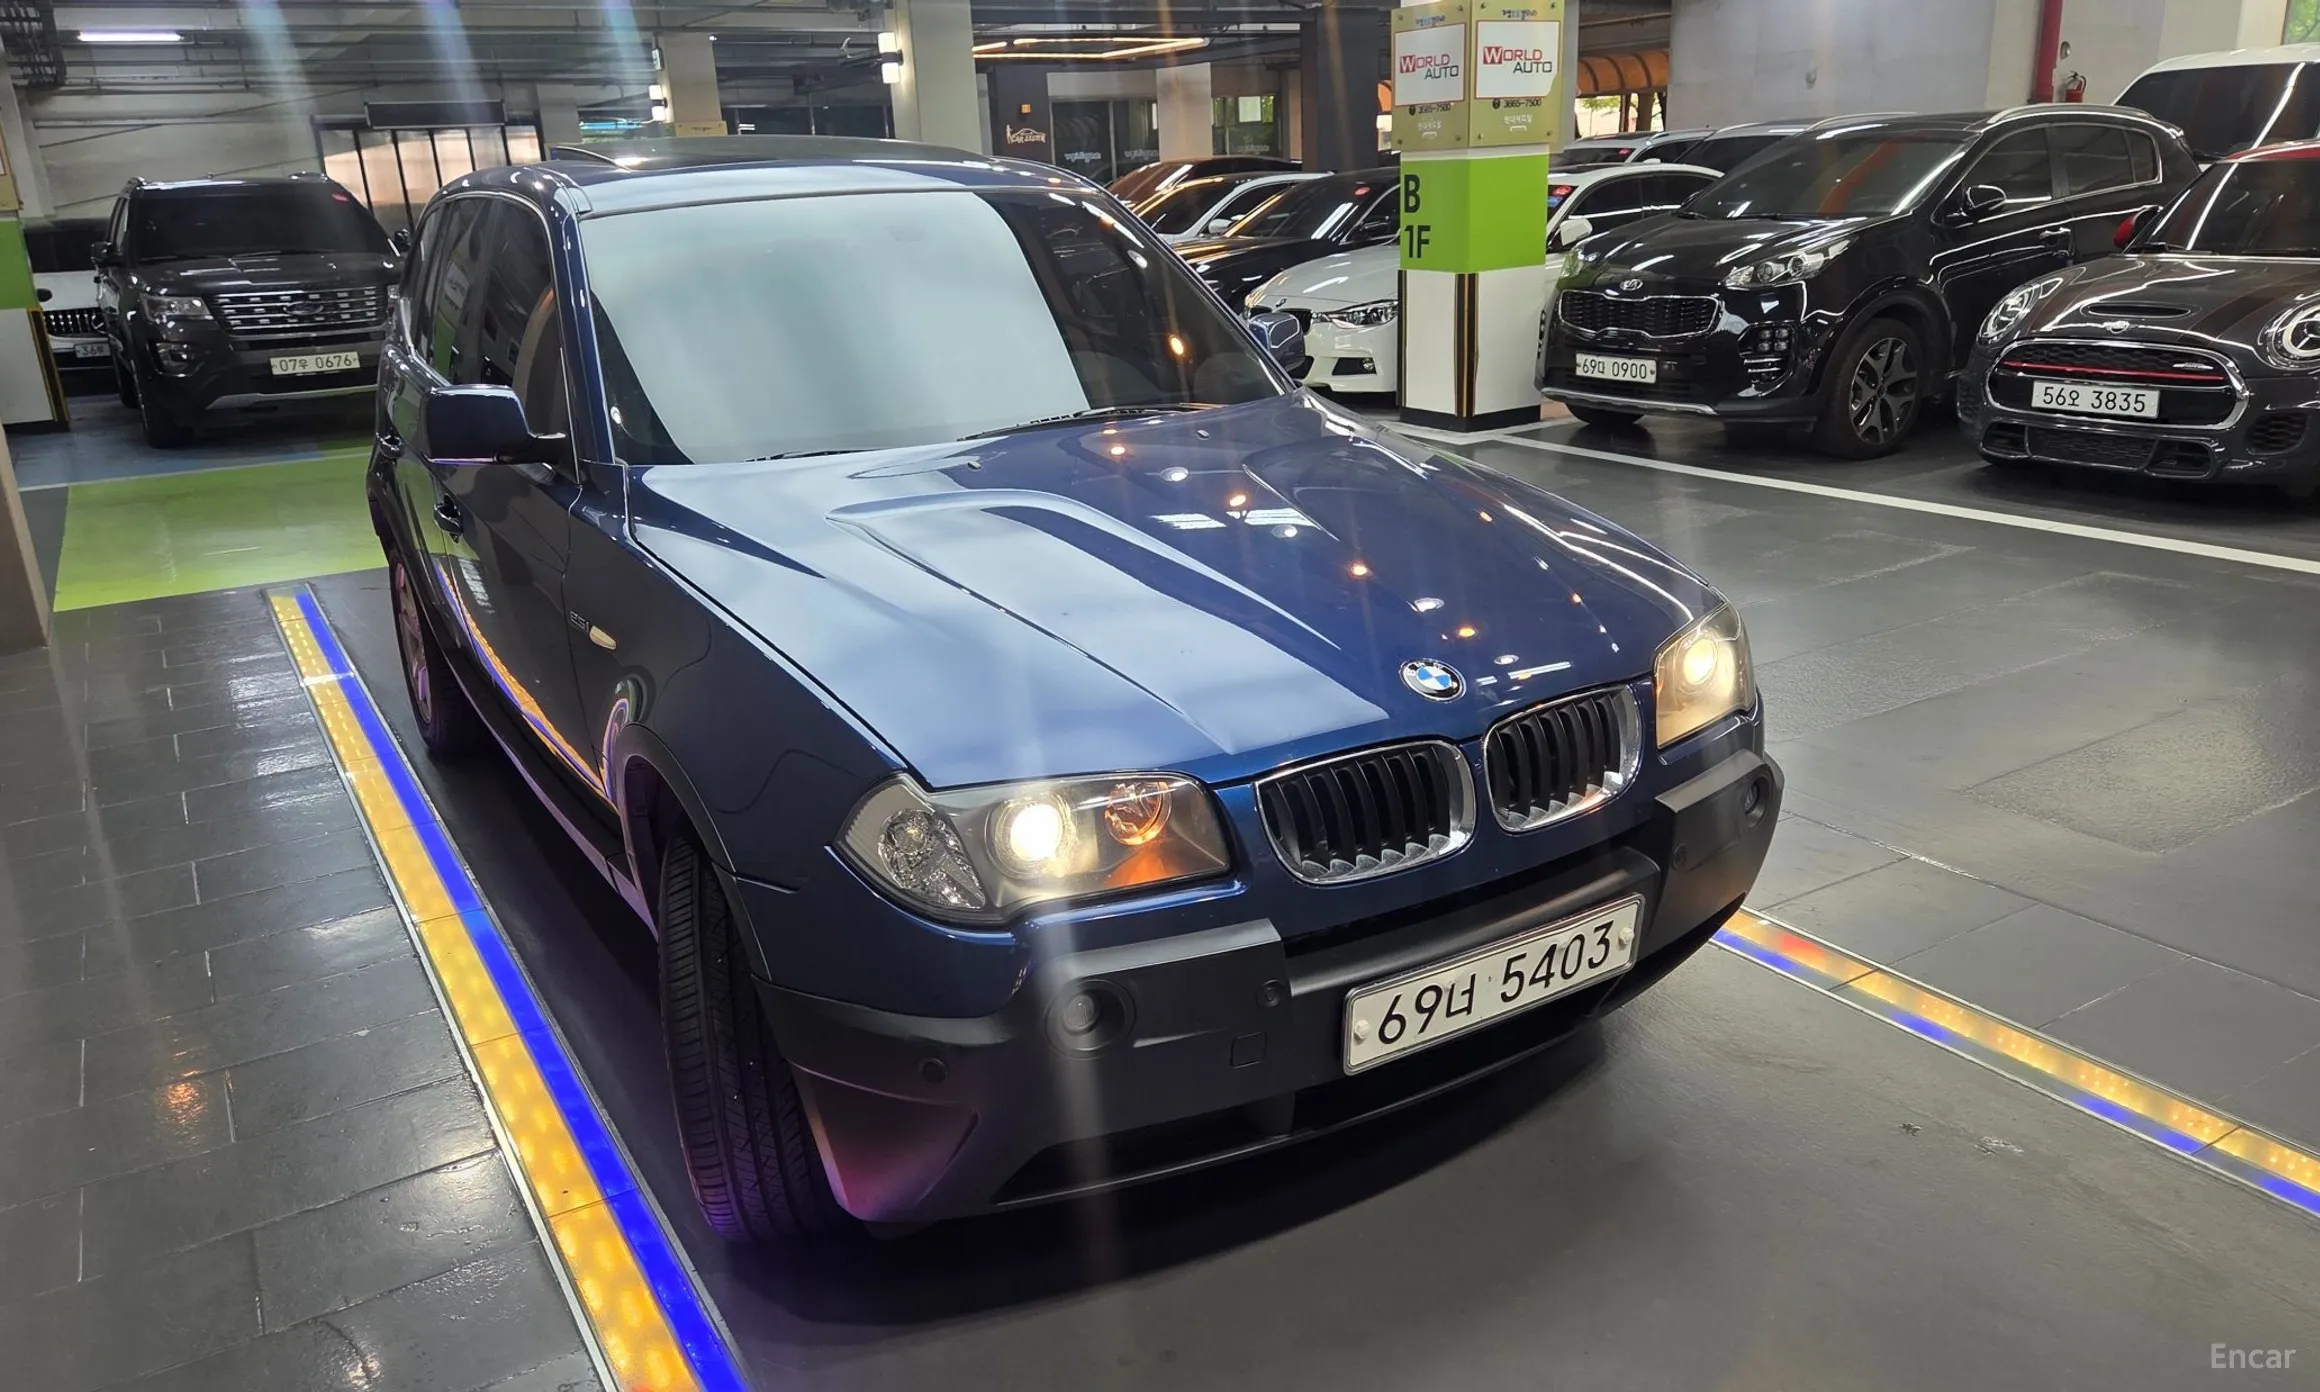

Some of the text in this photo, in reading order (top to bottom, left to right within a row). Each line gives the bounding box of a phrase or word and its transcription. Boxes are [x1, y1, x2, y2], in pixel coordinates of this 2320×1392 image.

[1400, 54, 1450, 73] WORLD
[1483, 46, 1543, 65] WORLD
[1424, 65, 1460, 80] AUTO
[1513, 61, 1553, 74] AUTO
[1503, 98, 1542, 109] 3665-7500
[1404, 174, 1421, 214] B
[1404, 224, 1431, 259] 1F
[279, 354, 352, 372] 07우 0676
[1611, 361, 1647, 379] 0900
[2043, 386, 2146, 412] 56오 3835
[1378, 920, 1614, 1044] 69너 5403
